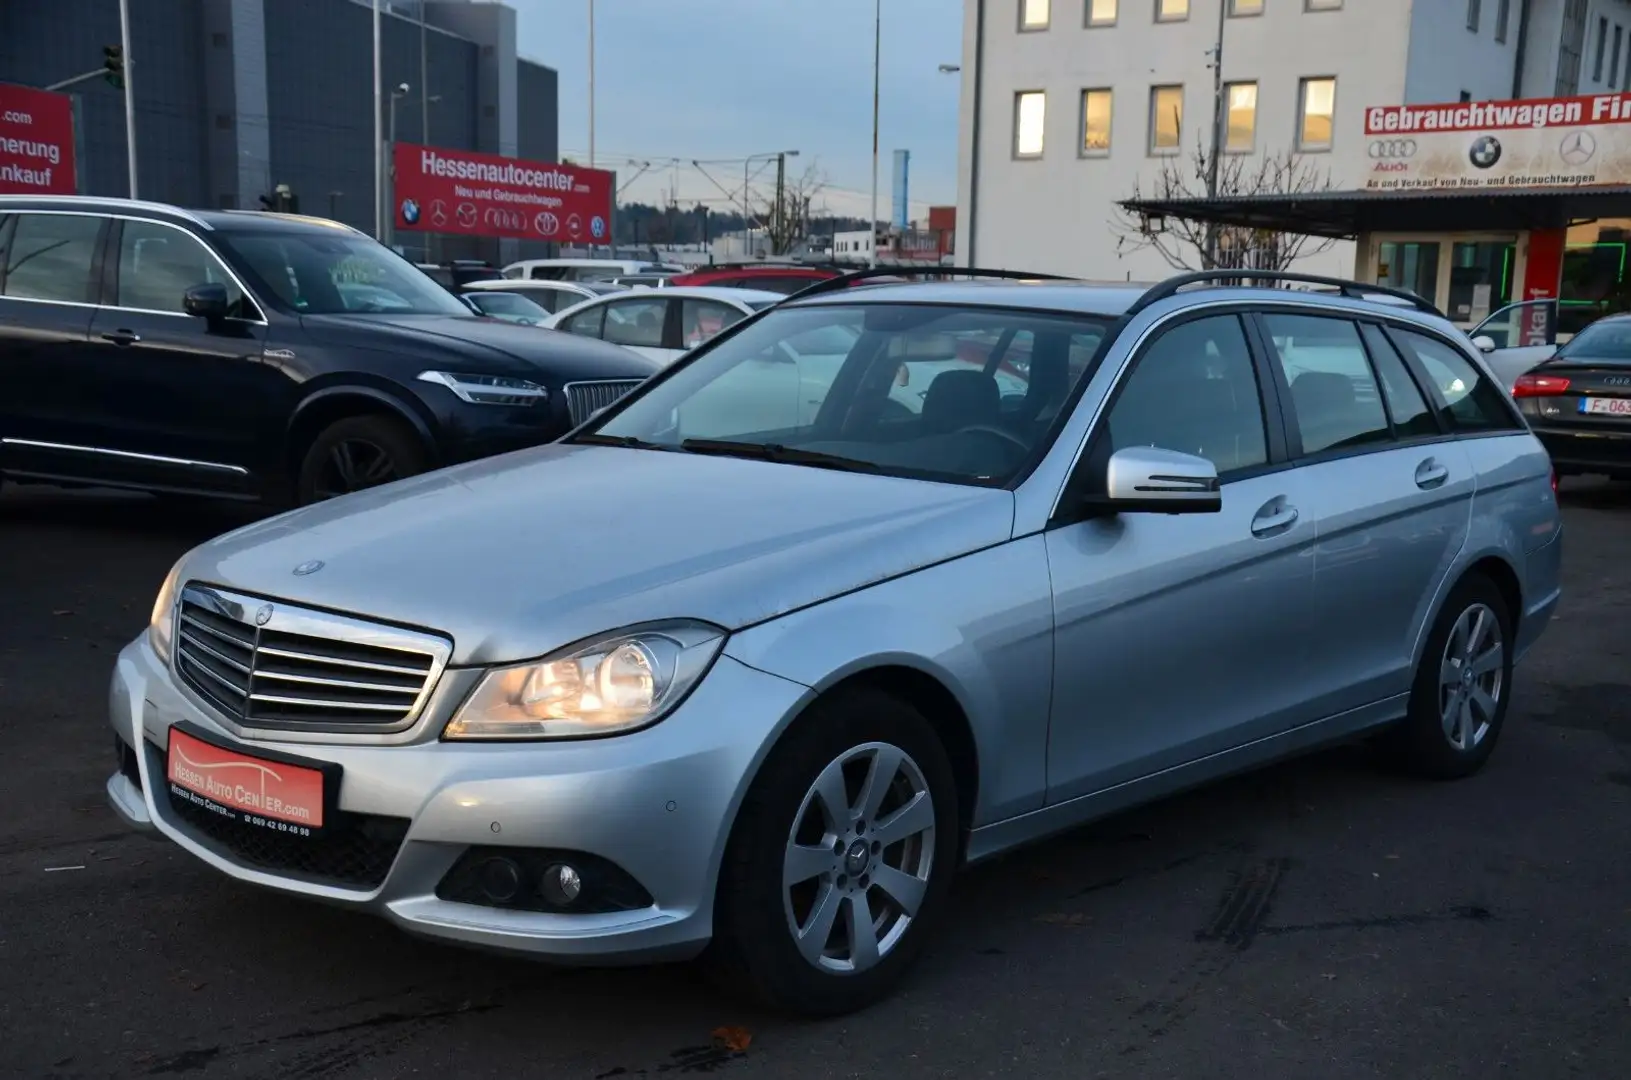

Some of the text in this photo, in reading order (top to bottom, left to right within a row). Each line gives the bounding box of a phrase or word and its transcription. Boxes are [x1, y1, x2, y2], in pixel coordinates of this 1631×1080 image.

[1368, 100, 1583, 131] Gebrauchtwagen
[0, 164, 52, 187] nkauf
[1366, 179, 1379, 188] An
[1382, 178, 1398, 188] und
[1401, 177, 1439, 188] Verkauf
[1440, 179, 1457, 187] von
[1487, 175, 1505, 186] und
[1508, 173, 1596, 187] Gebrauchtwagen
[455, 185, 563, 209] Neu und Gebrauchtwagen
[252, 817, 310, 837] 069 42 69 48 98
